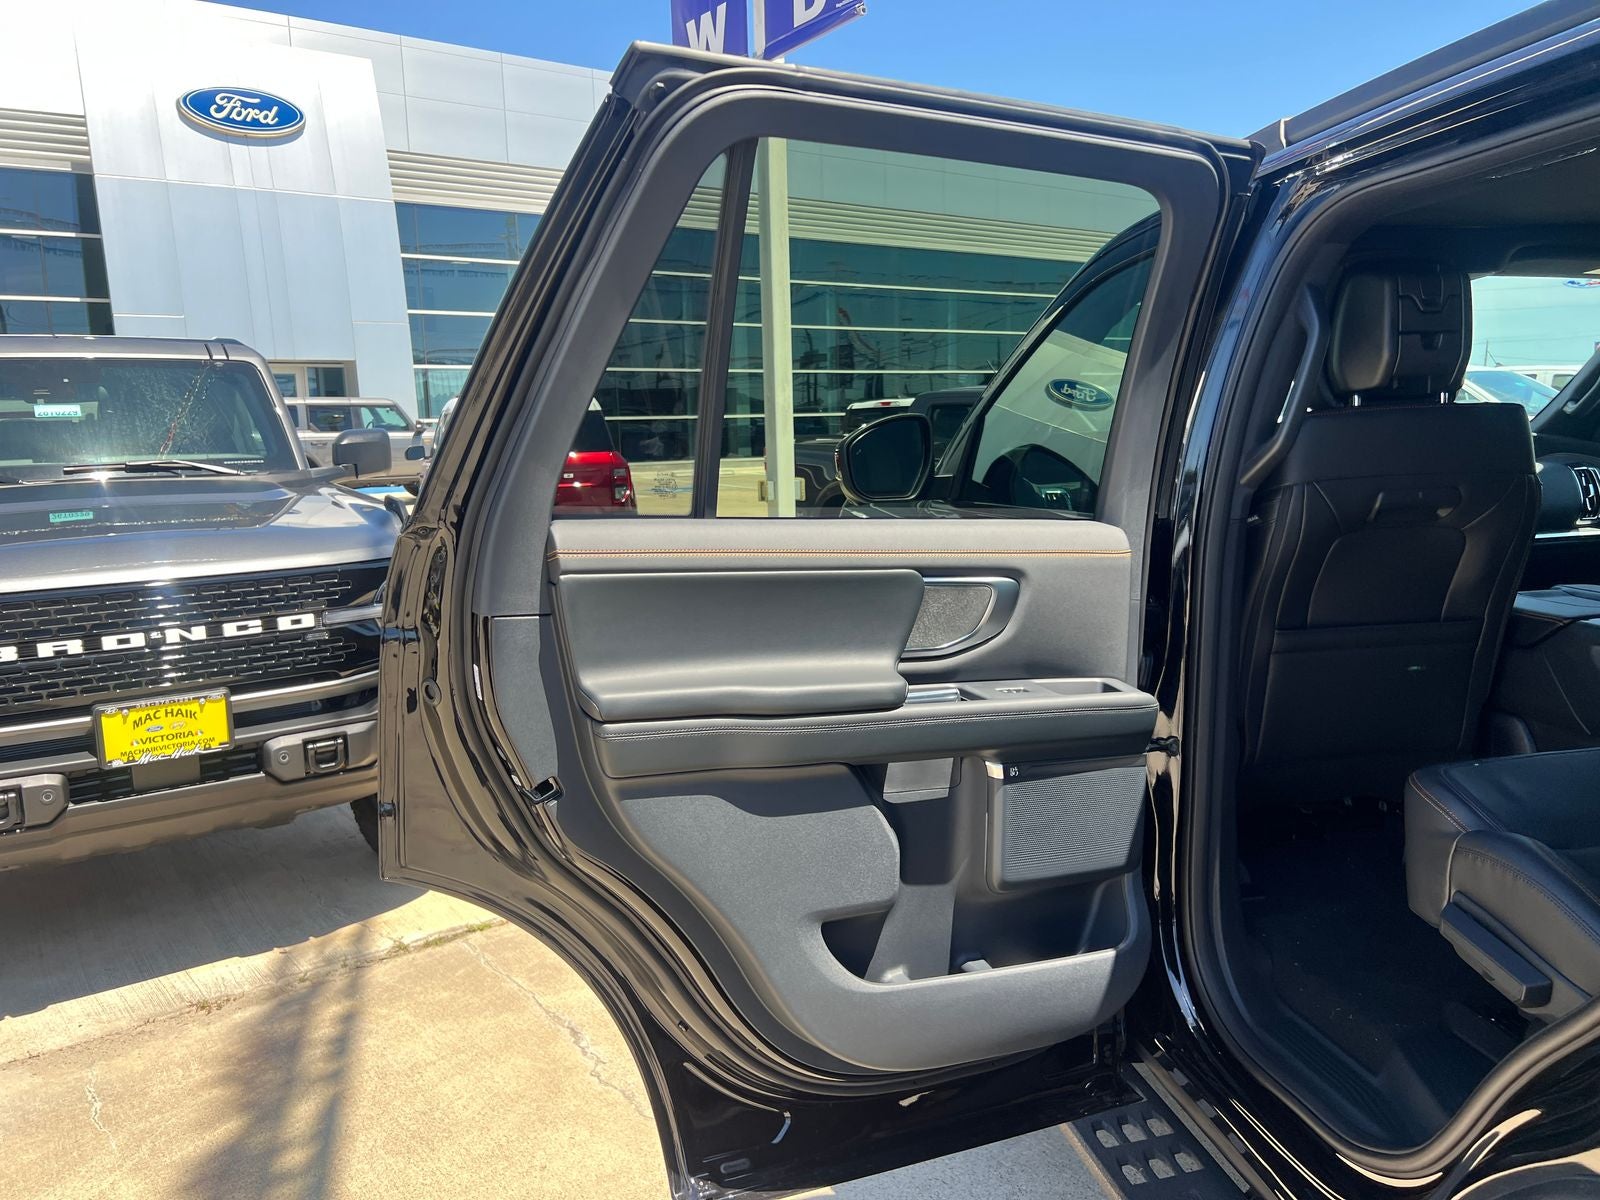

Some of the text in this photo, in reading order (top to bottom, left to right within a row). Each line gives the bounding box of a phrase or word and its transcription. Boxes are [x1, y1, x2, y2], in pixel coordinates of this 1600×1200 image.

[686, 2, 727, 54] W
[209, 92, 279, 125] Ford
[133, 709, 161, 730] MAC
[164, 707, 198, 720] HAIK
[140, 731, 194, 744] VICTORIA
